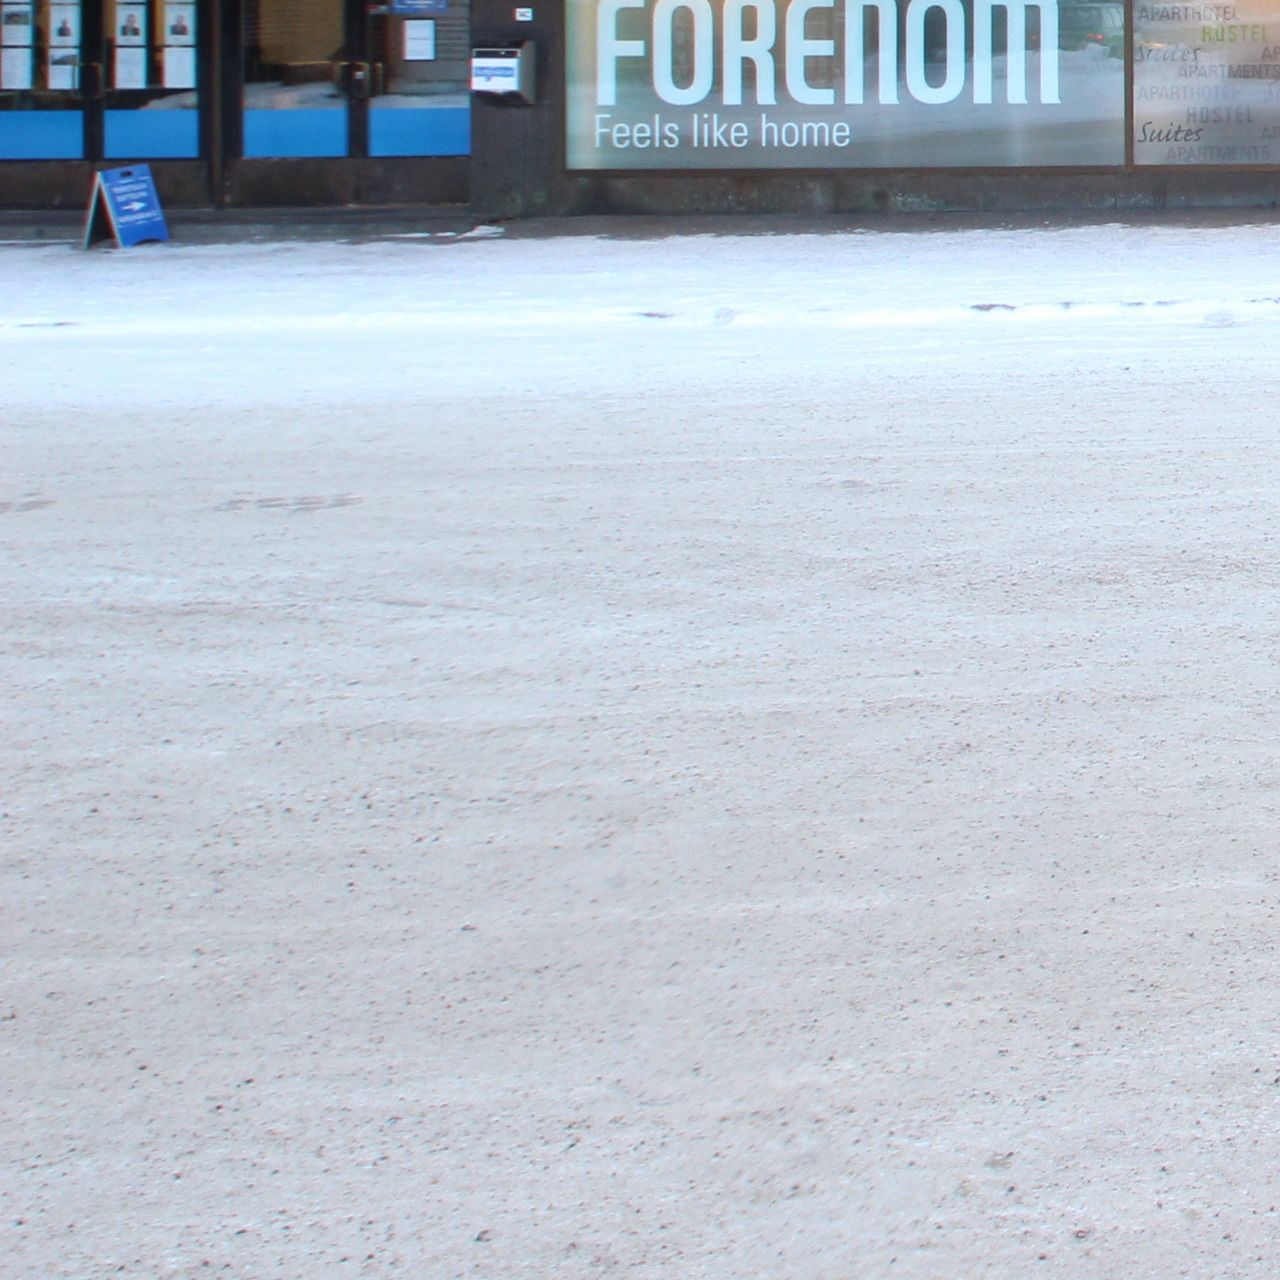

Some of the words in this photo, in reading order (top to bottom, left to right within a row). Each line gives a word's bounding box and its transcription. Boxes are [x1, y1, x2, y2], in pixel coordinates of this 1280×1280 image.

[1139, 6, 1239, 21] APARTHOTEL
[1202, 25, 1268, 42] HOSTEL
[1177, 64, 1280, 79] APARTMENTS
[1186, 106, 1253, 123] HOSTEL
[595, 114, 679, 148] Feels
[692, 113, 749, 148] like
[760, 113, 850, 148] home
[1137, 121, 1203, 143] Suites
[1167, 145, 1271, 160] APARTMENTS
